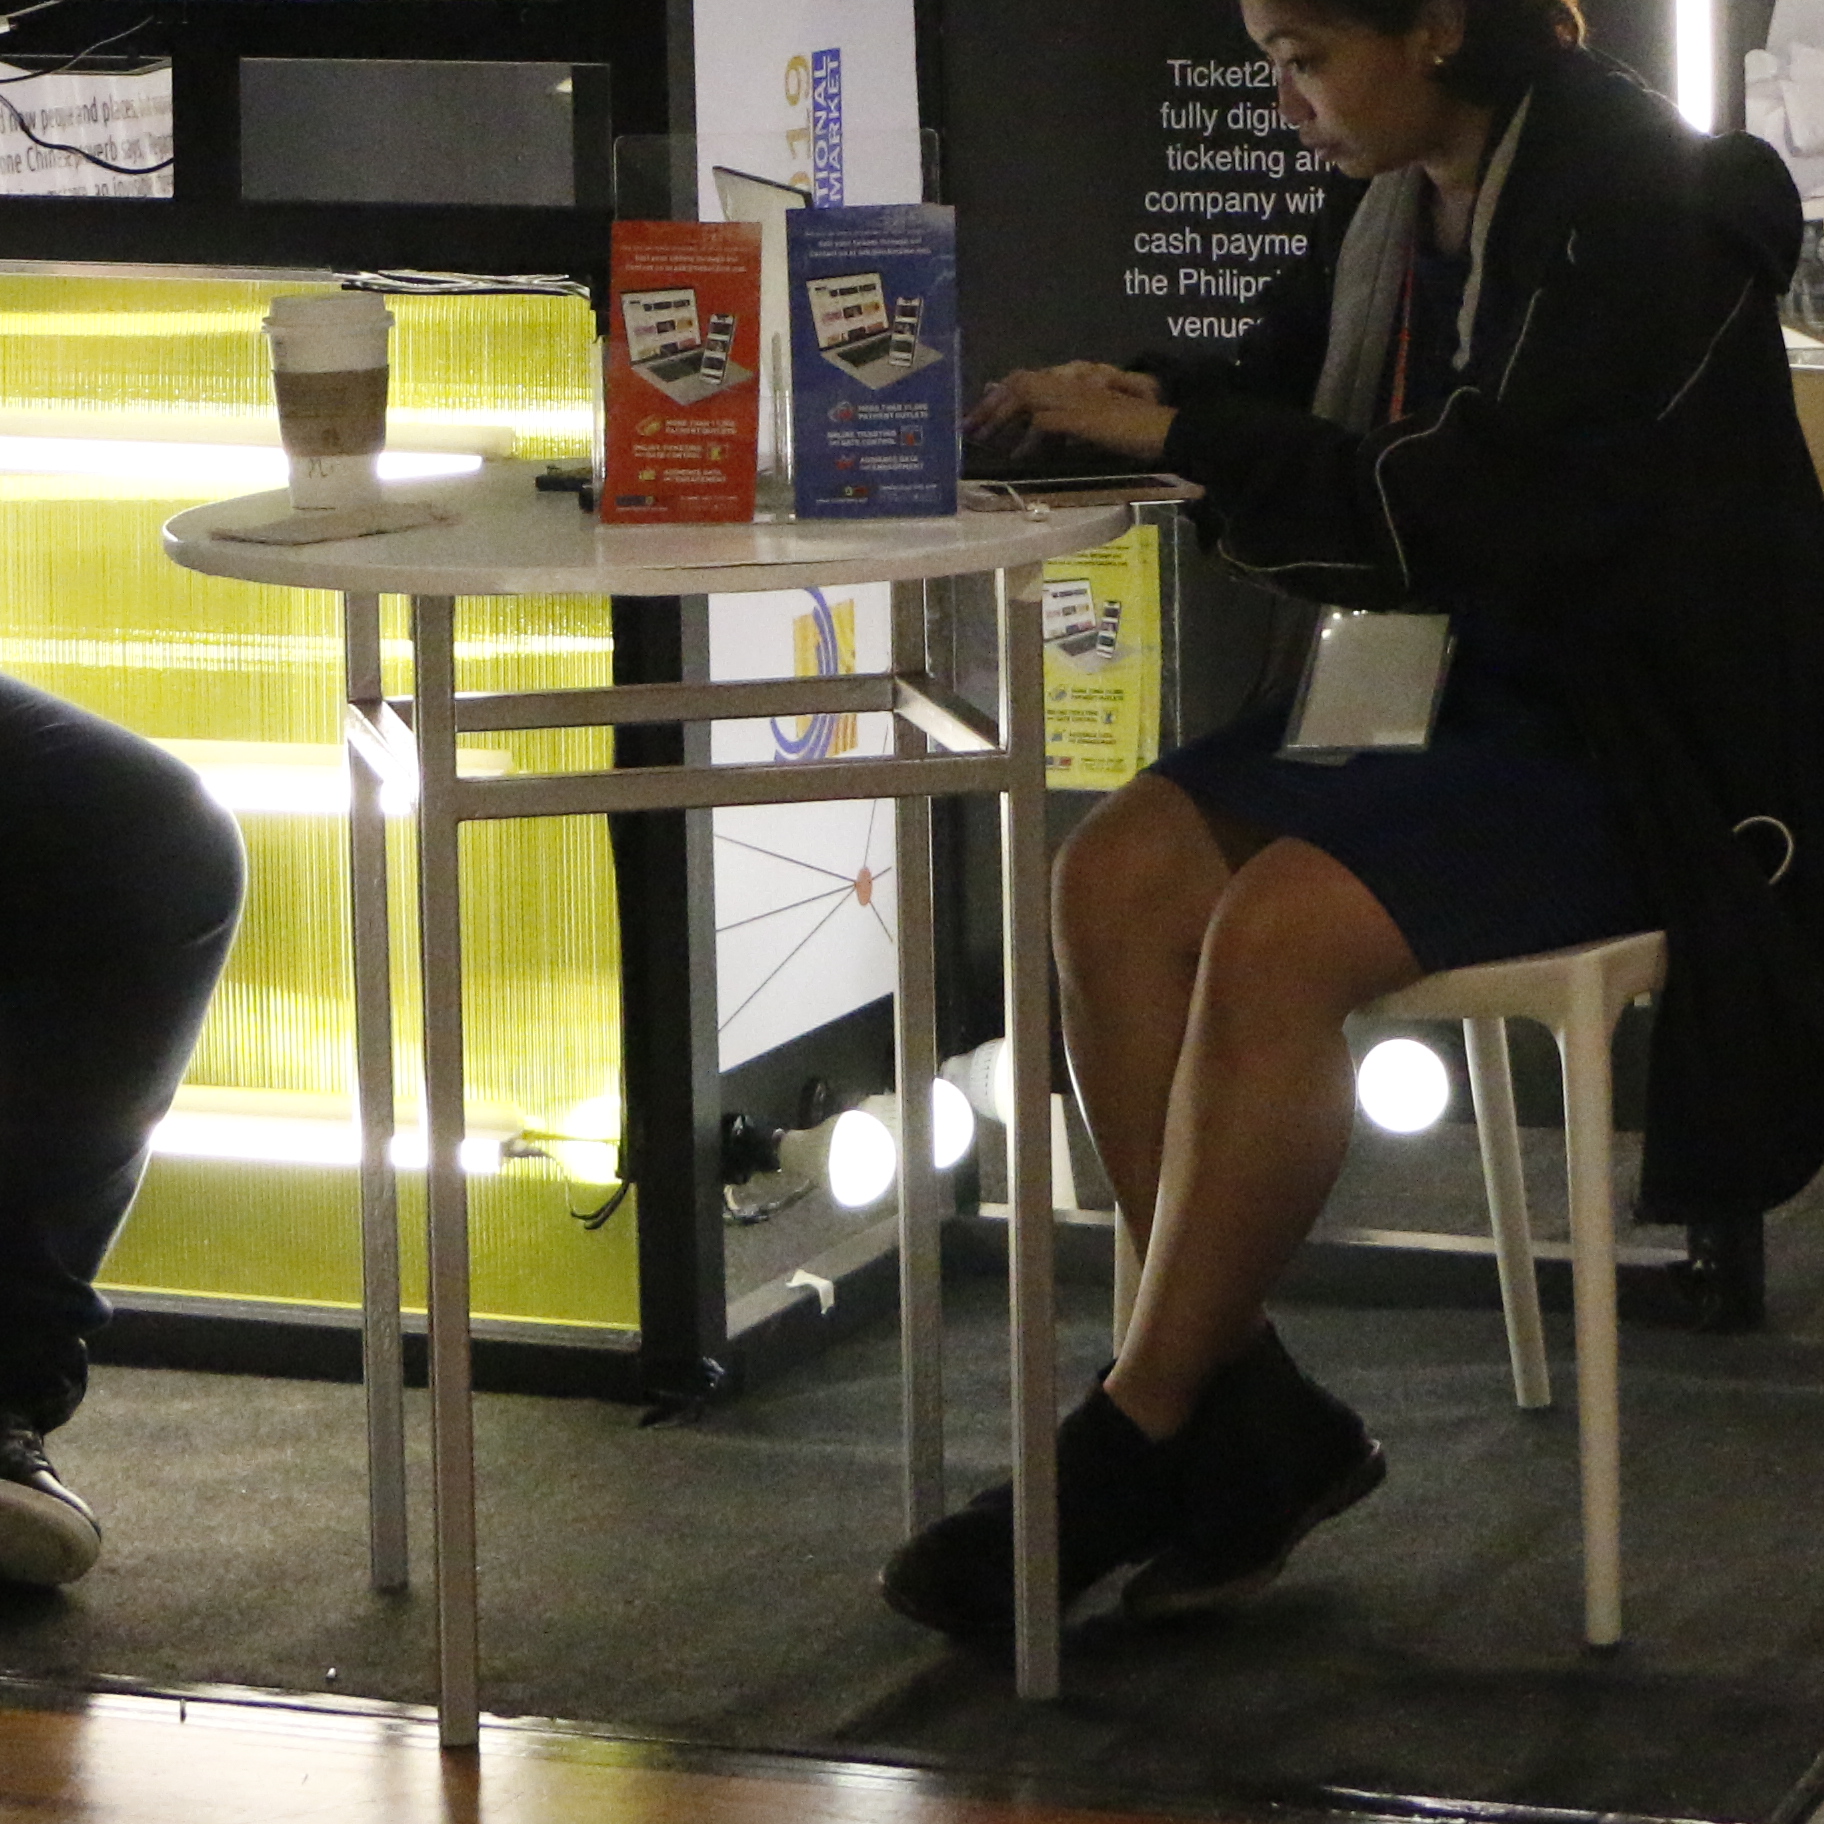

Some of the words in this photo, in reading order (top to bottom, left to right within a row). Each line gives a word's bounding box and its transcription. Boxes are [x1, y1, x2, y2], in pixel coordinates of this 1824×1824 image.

[827, 55, 842, 202] MARKET
[1159, 101, 1219, 137] fully
[1166, 143, 1286, 178] ticketing
[1144, 190, 1277, 220] company
[1133, 226, 1202, 255] cash
[1211, 232, 1308, 262] payme
[1124, 267, 1169, 296] the
